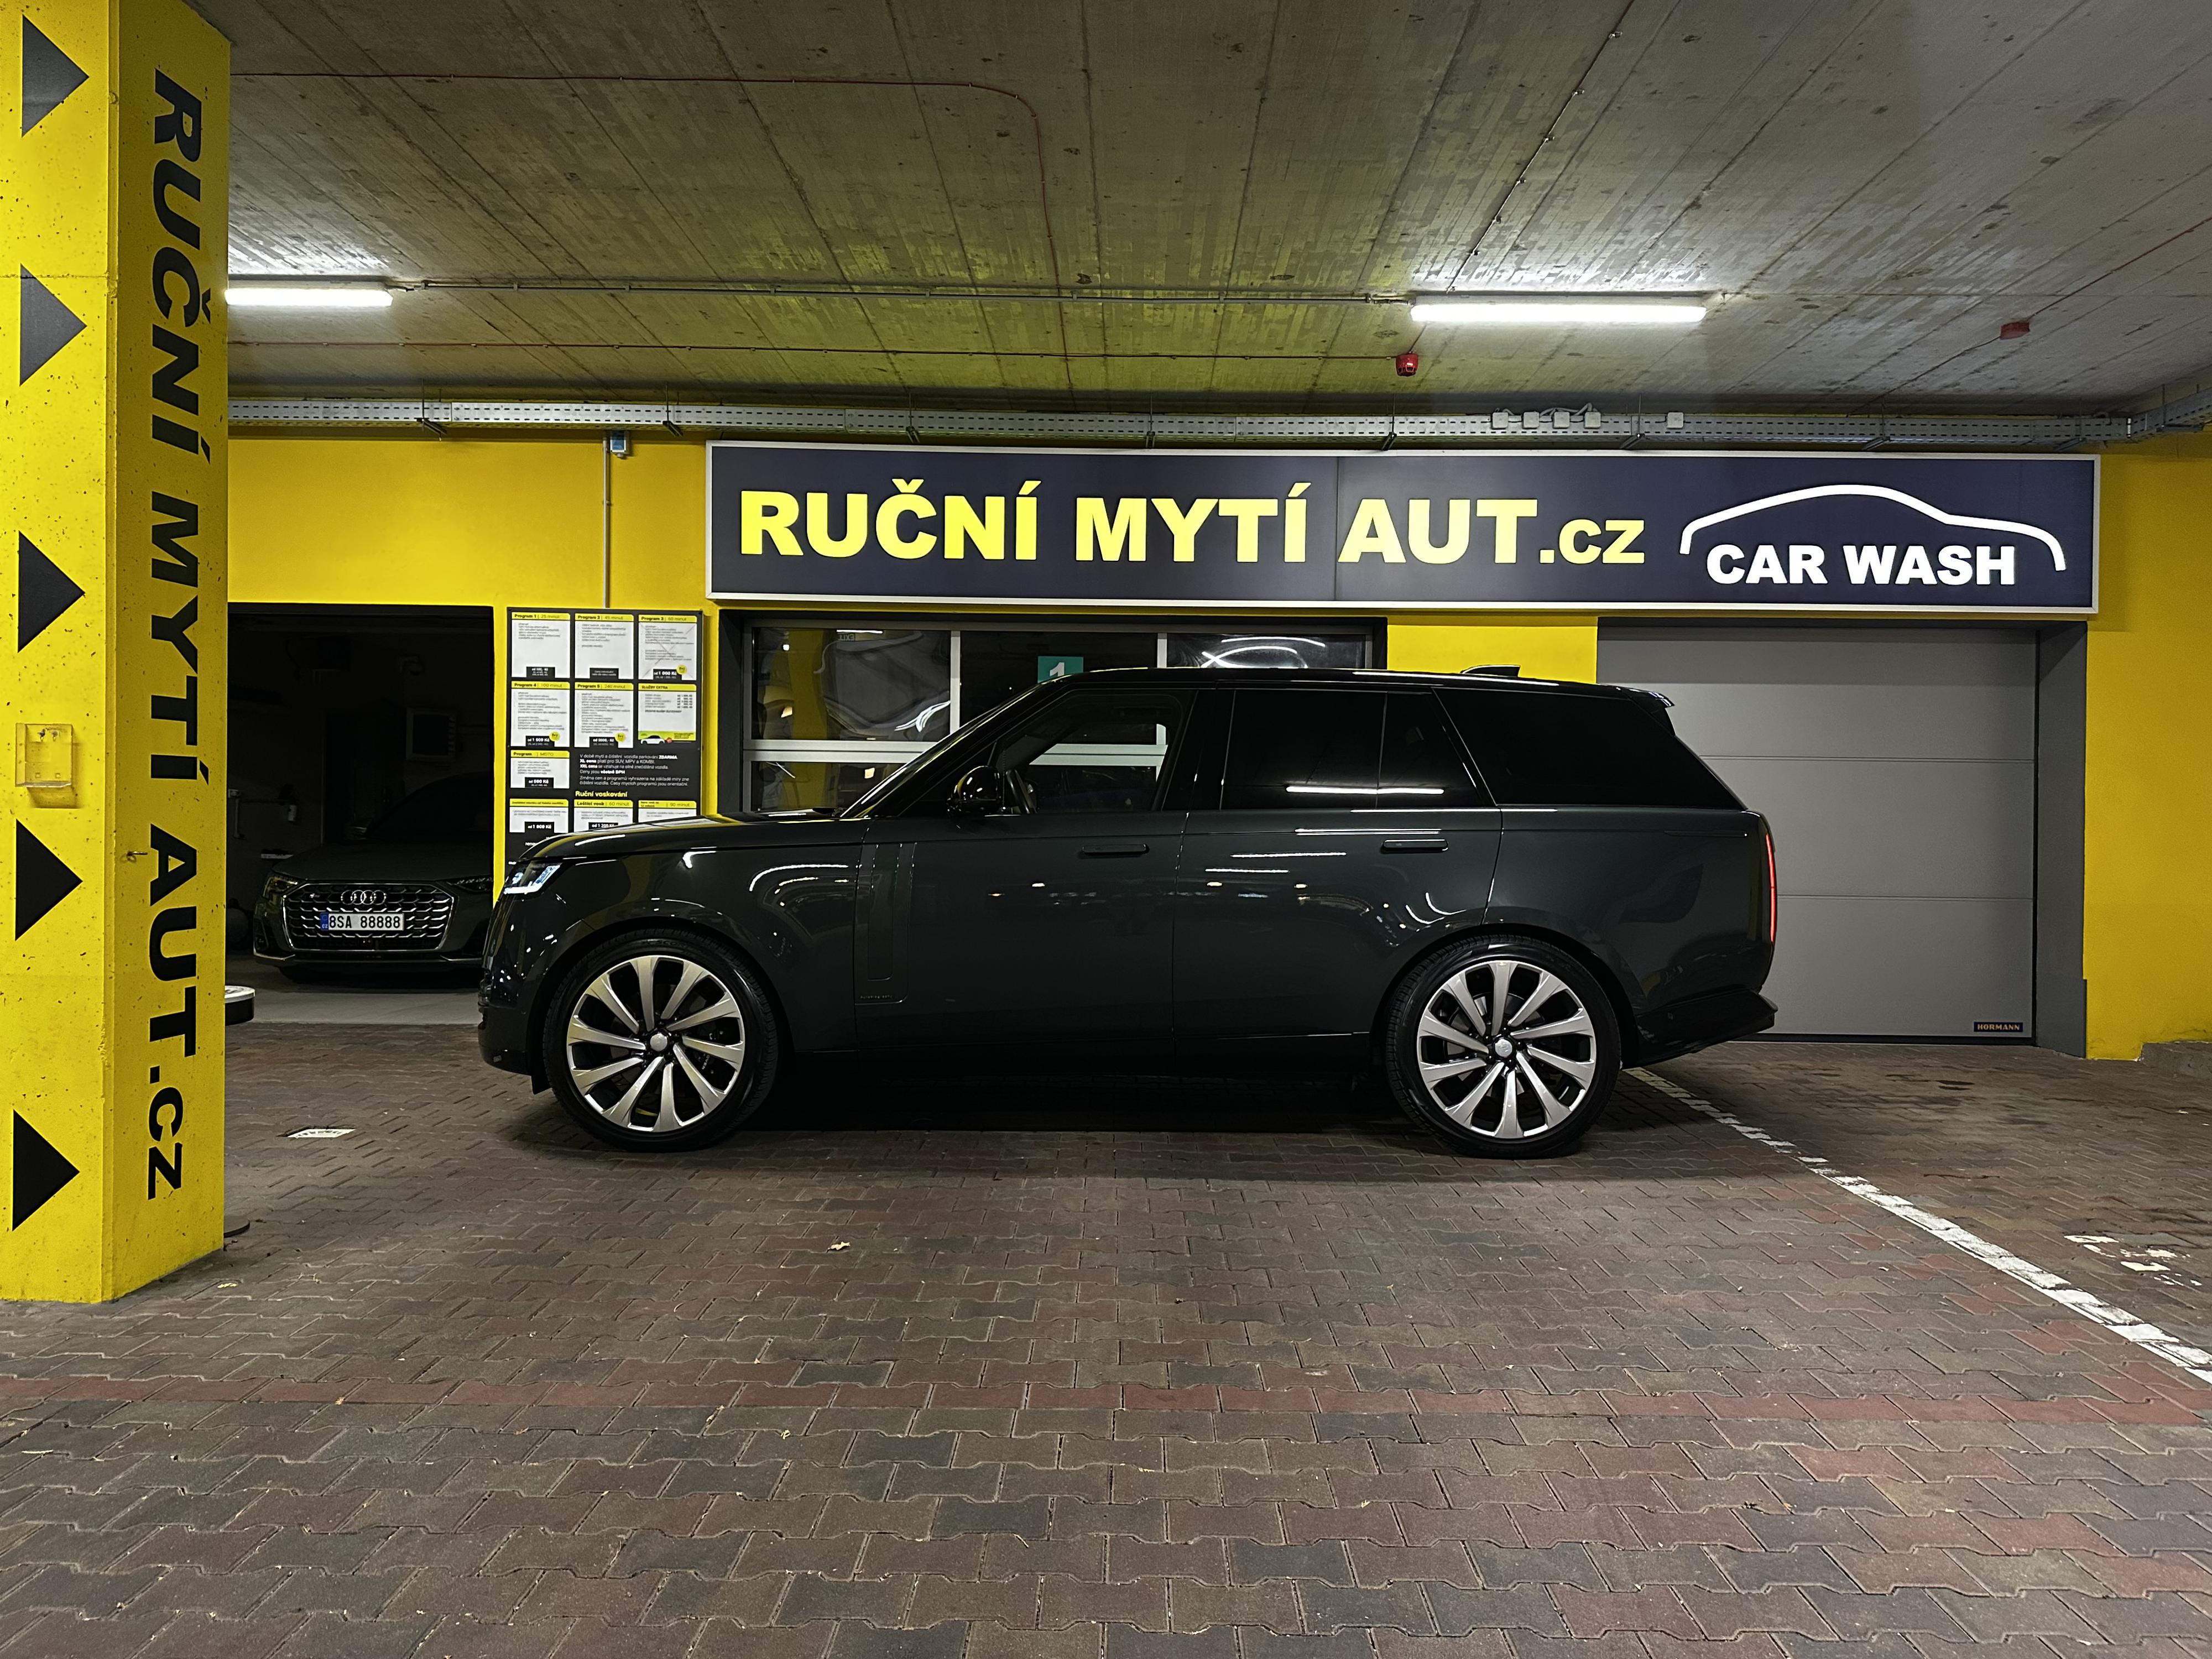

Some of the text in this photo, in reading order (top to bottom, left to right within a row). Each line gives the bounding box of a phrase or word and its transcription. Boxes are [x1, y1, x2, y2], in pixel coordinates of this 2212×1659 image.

[741, 478, 1645, 564] RUČNÍ MYTÍ AUT.cz
[1707, 544, 2015, 586] CAR WASH
[148, 67, 211, 1201] RUČNÍ MYTÍ AUT.cz
[1050, 662, 1065, 677] 1
[329, 915, 401, 928] 8SA 88888
